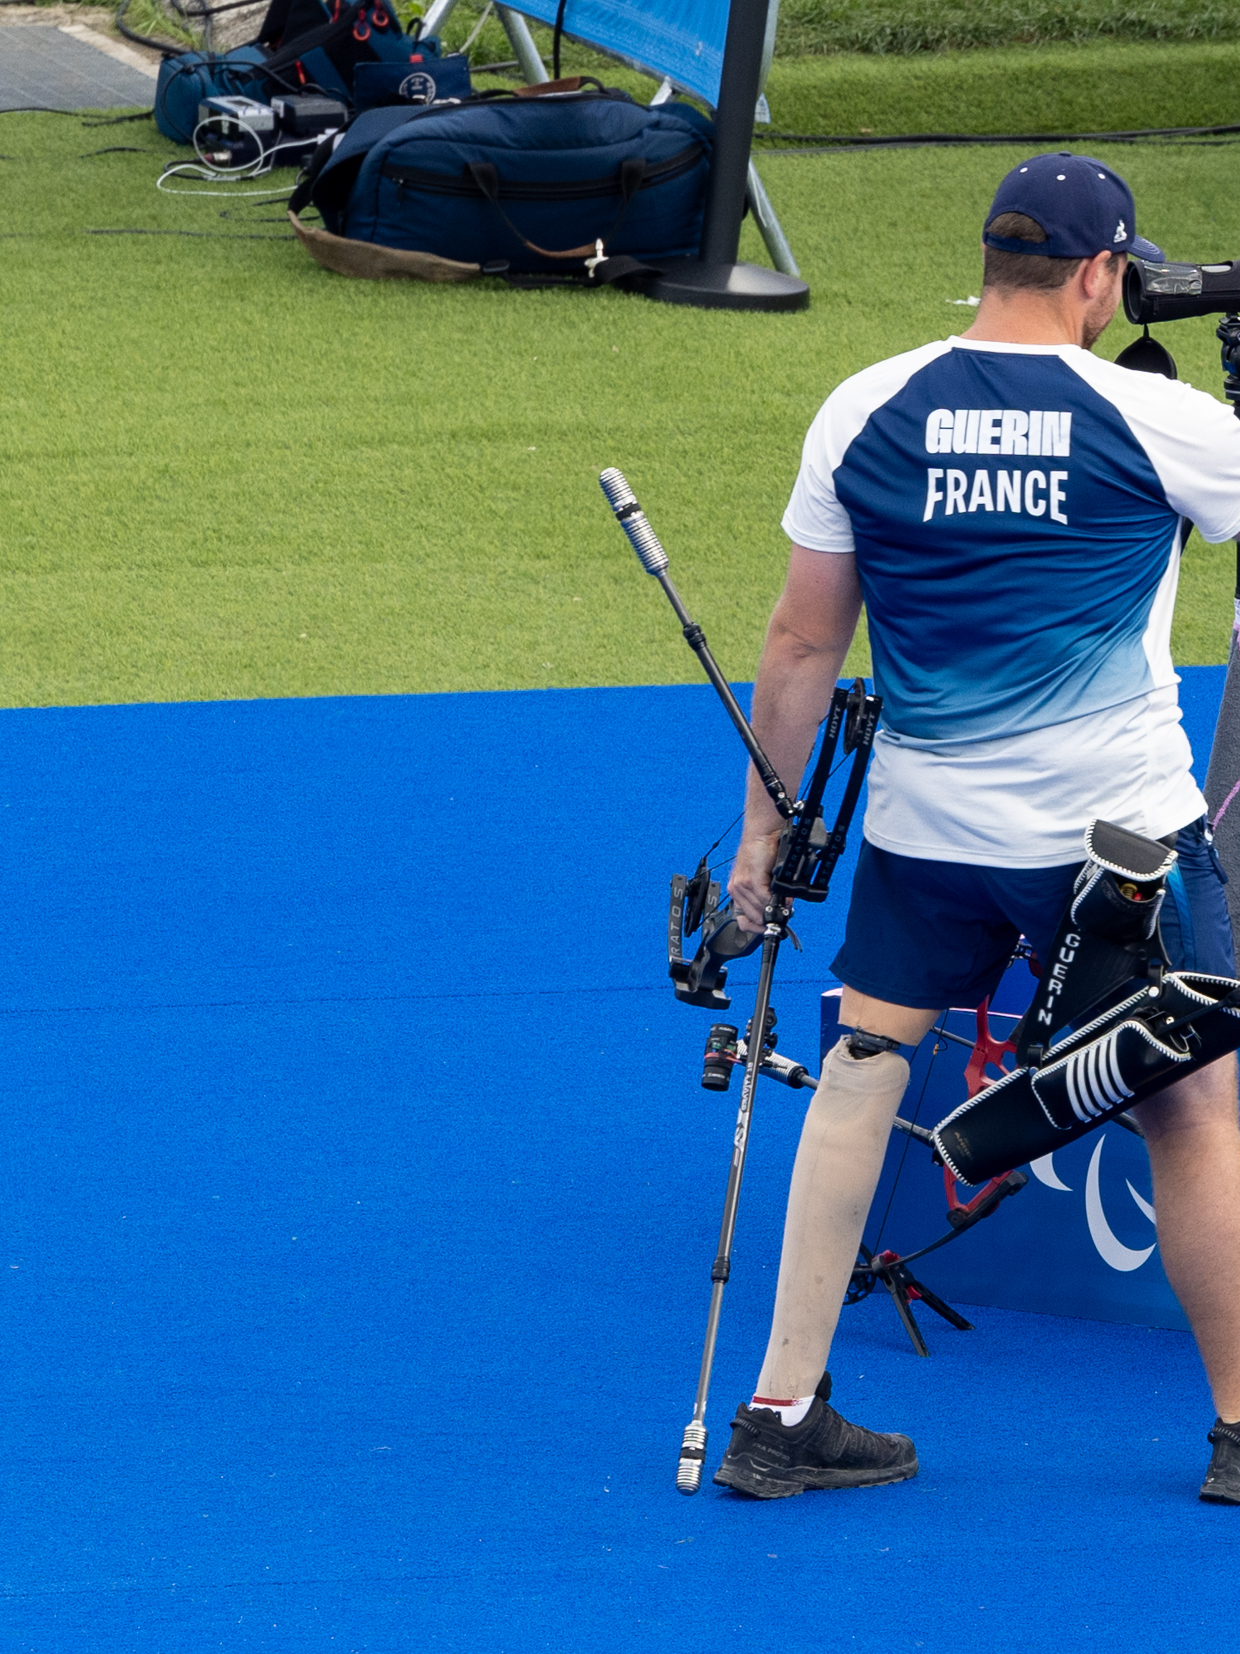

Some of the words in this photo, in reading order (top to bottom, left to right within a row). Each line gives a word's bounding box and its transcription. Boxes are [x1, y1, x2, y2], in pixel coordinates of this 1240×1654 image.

[925, 408, 1073, 457] GUERIN
[922, 467, 1069, 526] FRANCE
[828, 704, 841, 739] HOYT
[862, 711, 875, 746] HOYT
[785, 817, 812, 878] STRATOS
[819, 823, 846, 885] STRATOS
[670, 886, 684, 956] RATOS
[1038, 933, 1081, 1026] GUERIN
